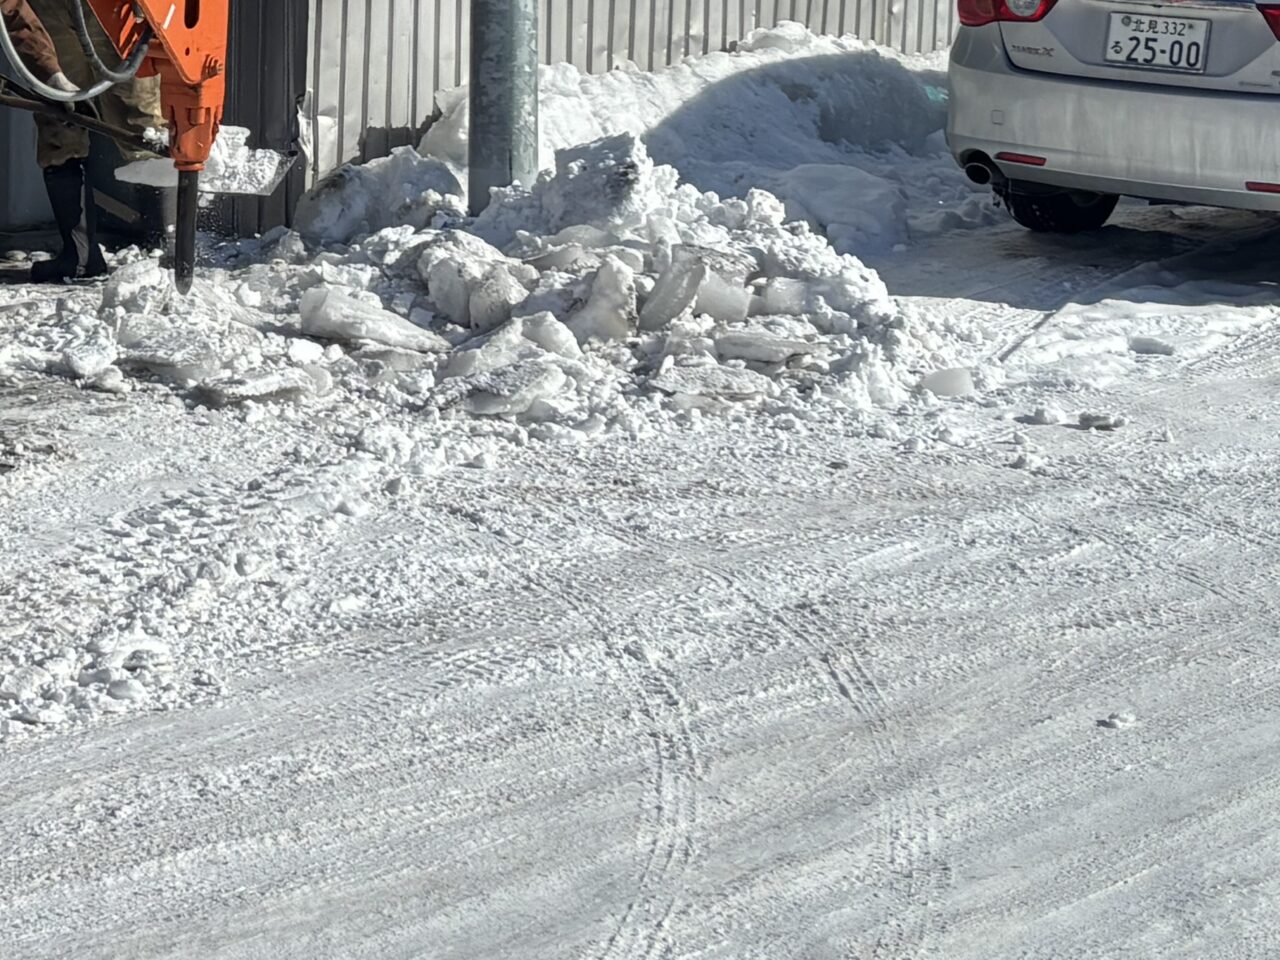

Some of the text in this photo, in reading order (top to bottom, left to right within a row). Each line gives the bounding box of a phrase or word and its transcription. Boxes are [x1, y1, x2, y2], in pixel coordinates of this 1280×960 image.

[1131, 19, 1186, 36] 北見 332
[1110, 36, 1200, 67] る 25-00
